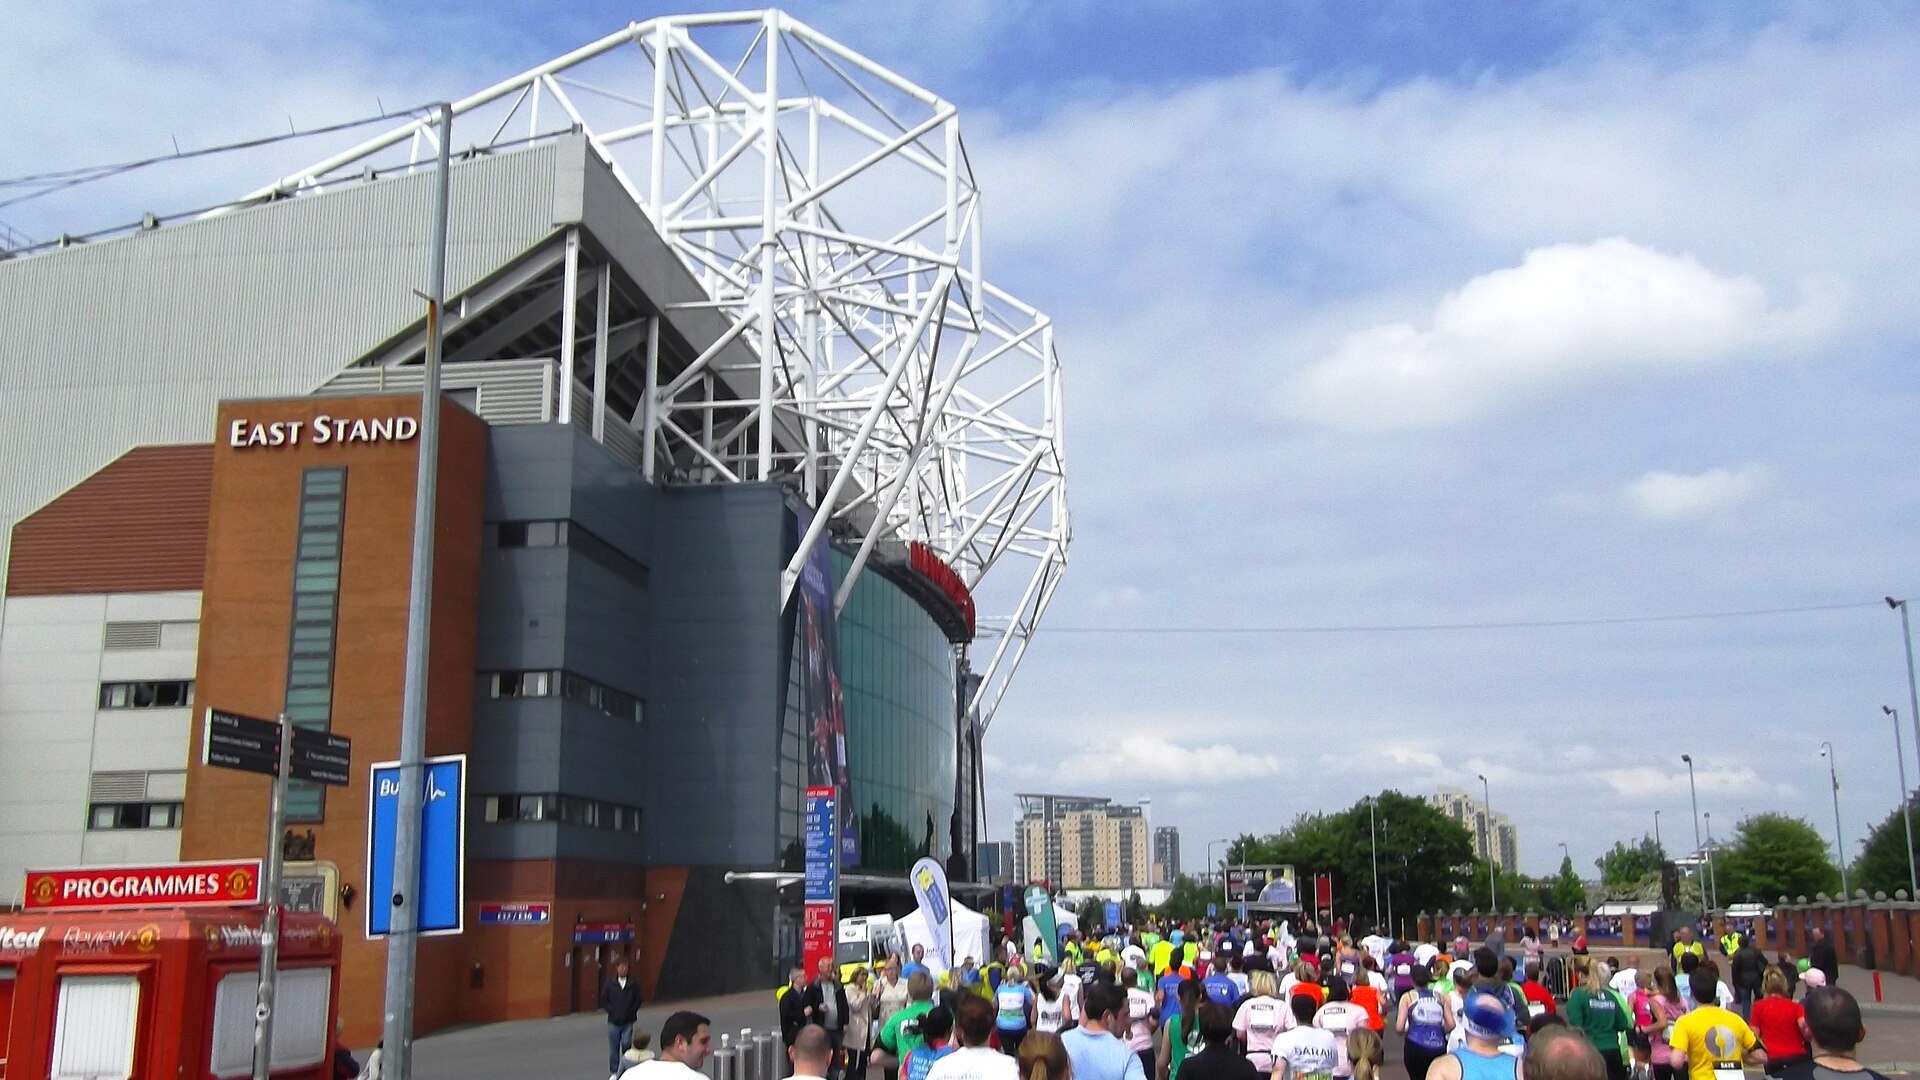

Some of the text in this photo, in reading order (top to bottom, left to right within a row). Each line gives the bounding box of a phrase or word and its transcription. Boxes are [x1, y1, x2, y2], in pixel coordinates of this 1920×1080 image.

[230, 414, 418, 448] EAST STAND
[62, 872, 220, 899] PROGRAMMES
[63, 926, 131, 949] Review
